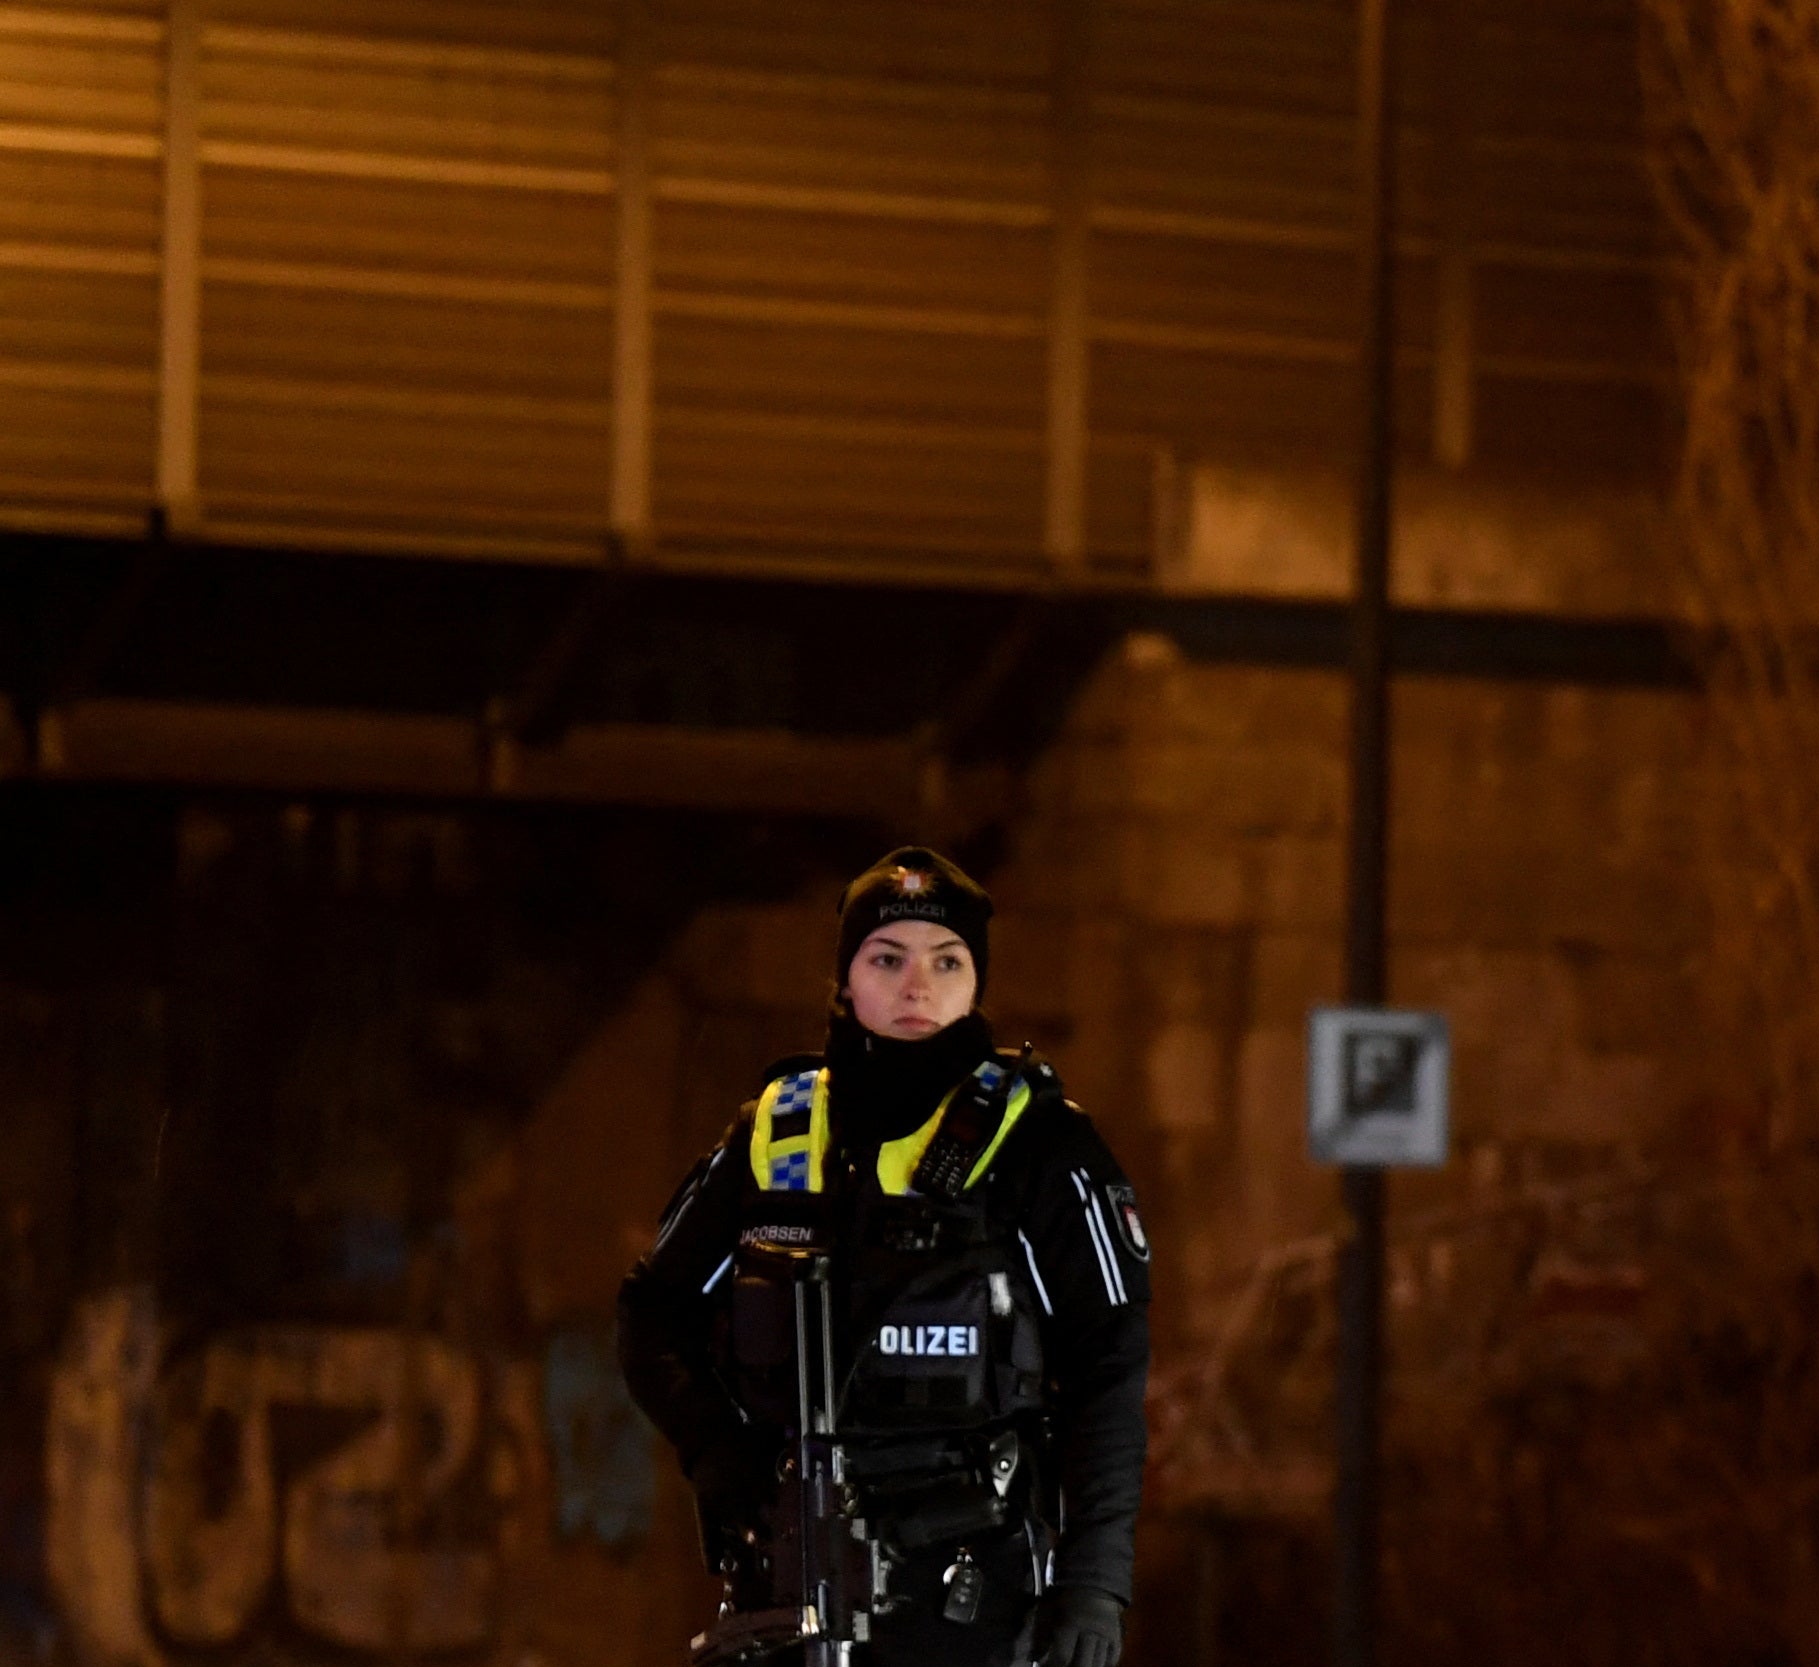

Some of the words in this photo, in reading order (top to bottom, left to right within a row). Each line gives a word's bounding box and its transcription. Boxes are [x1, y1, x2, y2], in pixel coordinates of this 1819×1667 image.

[879, 901, 945, 920] POLIZEI
[740, 1225, 812, 1245] JACOBSEN
[879, 1325, 979, 1356] OLIZEI
